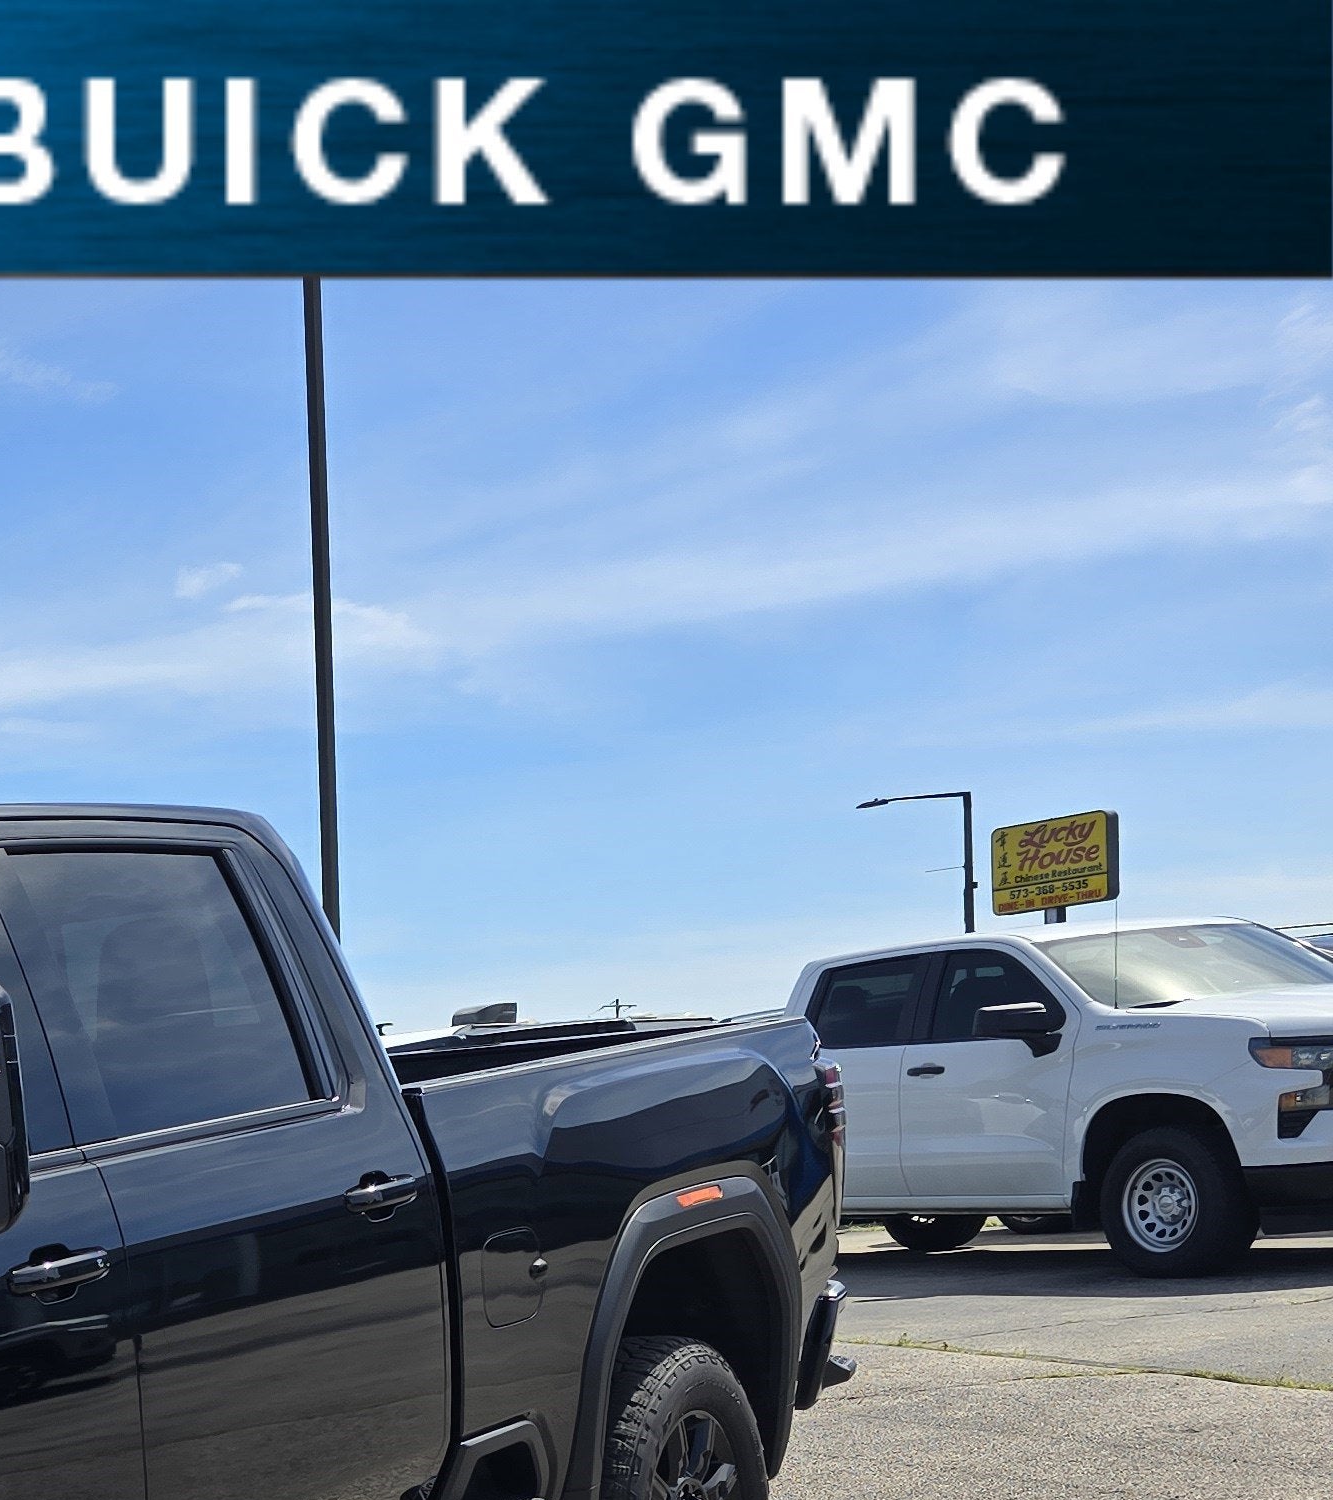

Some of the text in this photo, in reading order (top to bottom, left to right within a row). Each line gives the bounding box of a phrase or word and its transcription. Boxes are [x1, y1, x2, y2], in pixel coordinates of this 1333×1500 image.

[1018, 820, 1096, 848] Lucky
[1017, 844, 1100, 872] House
[1014, 862, 1103, 884] Chinese Restaurant
[1041, 888, 1102, 906] DRIVE-THRU
